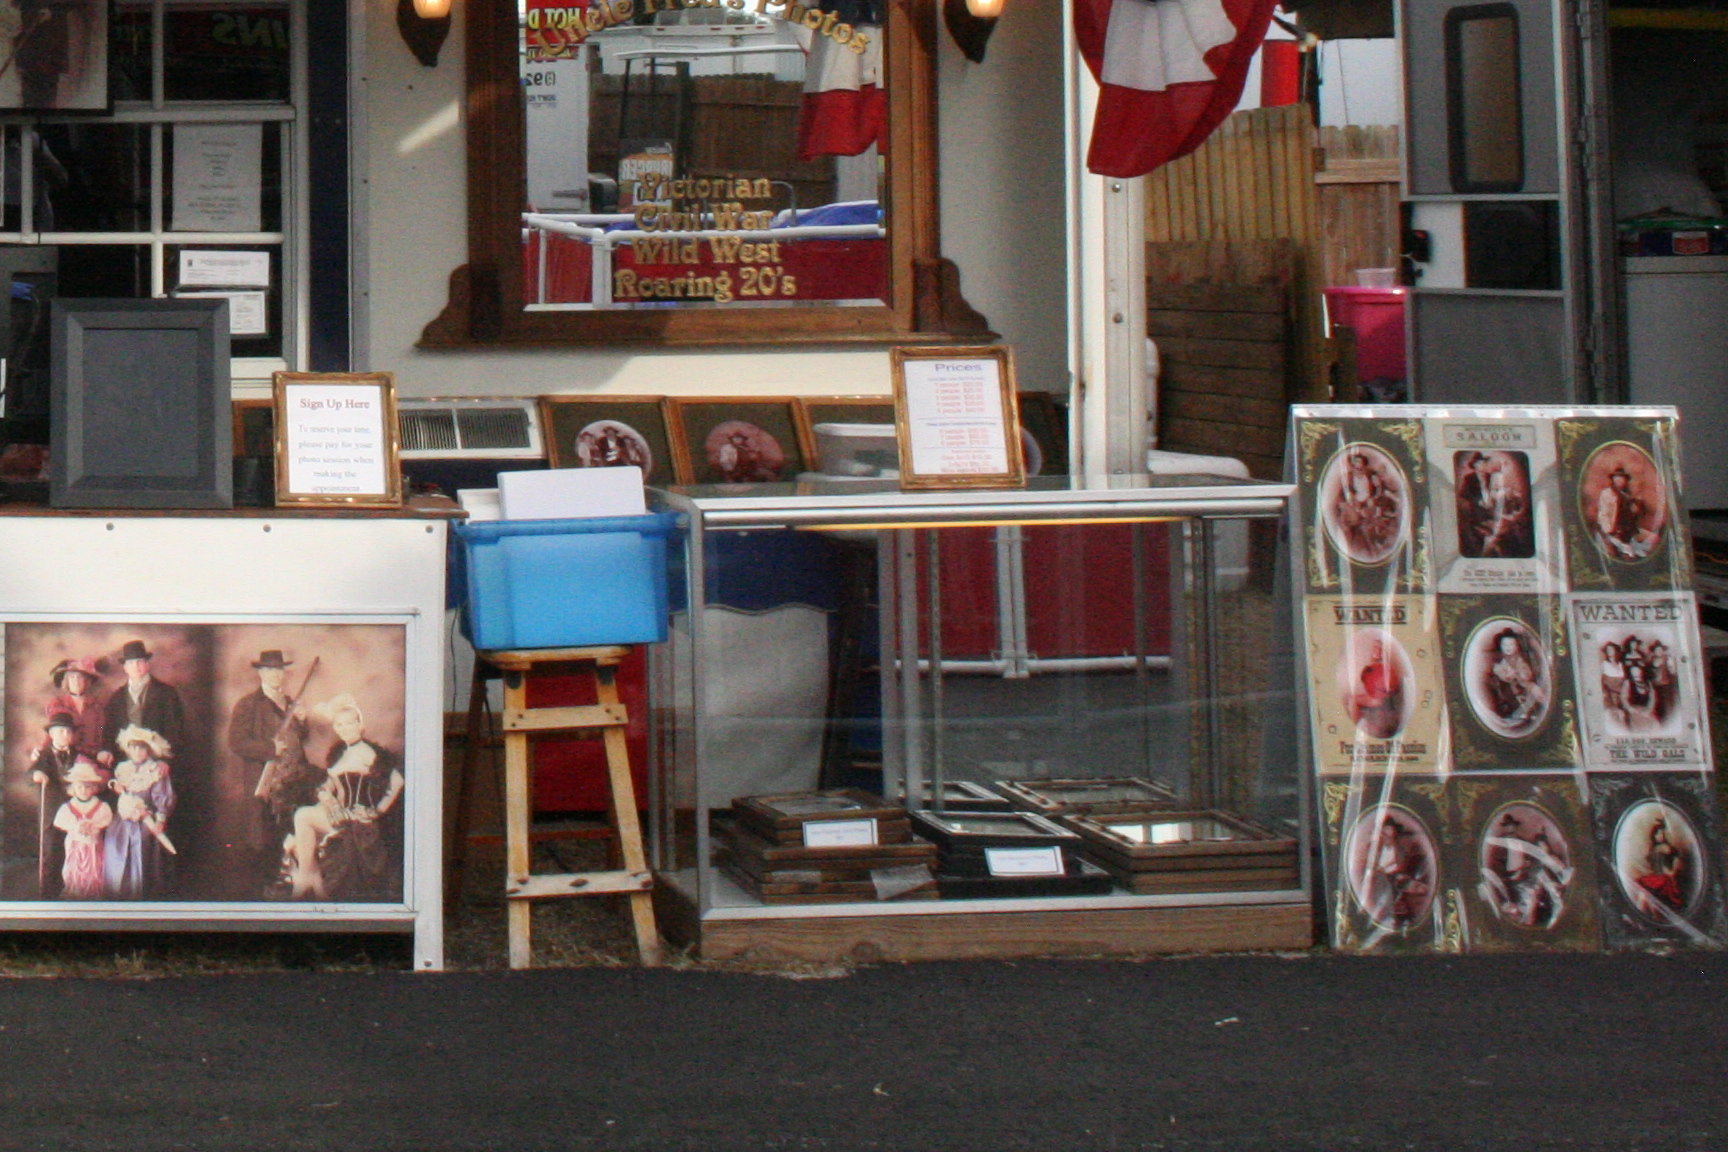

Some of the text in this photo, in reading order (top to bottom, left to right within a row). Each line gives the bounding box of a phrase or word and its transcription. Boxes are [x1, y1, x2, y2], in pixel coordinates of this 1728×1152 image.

[636, 172, 772, 201] Victorian
[634, 202, 775, 232] Civil War
[632, 236, 782, 265] Wild West
[613, 266, 798, 304] Roaring 20's
[935, 363, 982, 372] Prices
[300, 398, 370, 410] Sign Up Here
[1333, 607, 1407, 622] WANTD
[1580, 605, 1682, 621] WANTED
